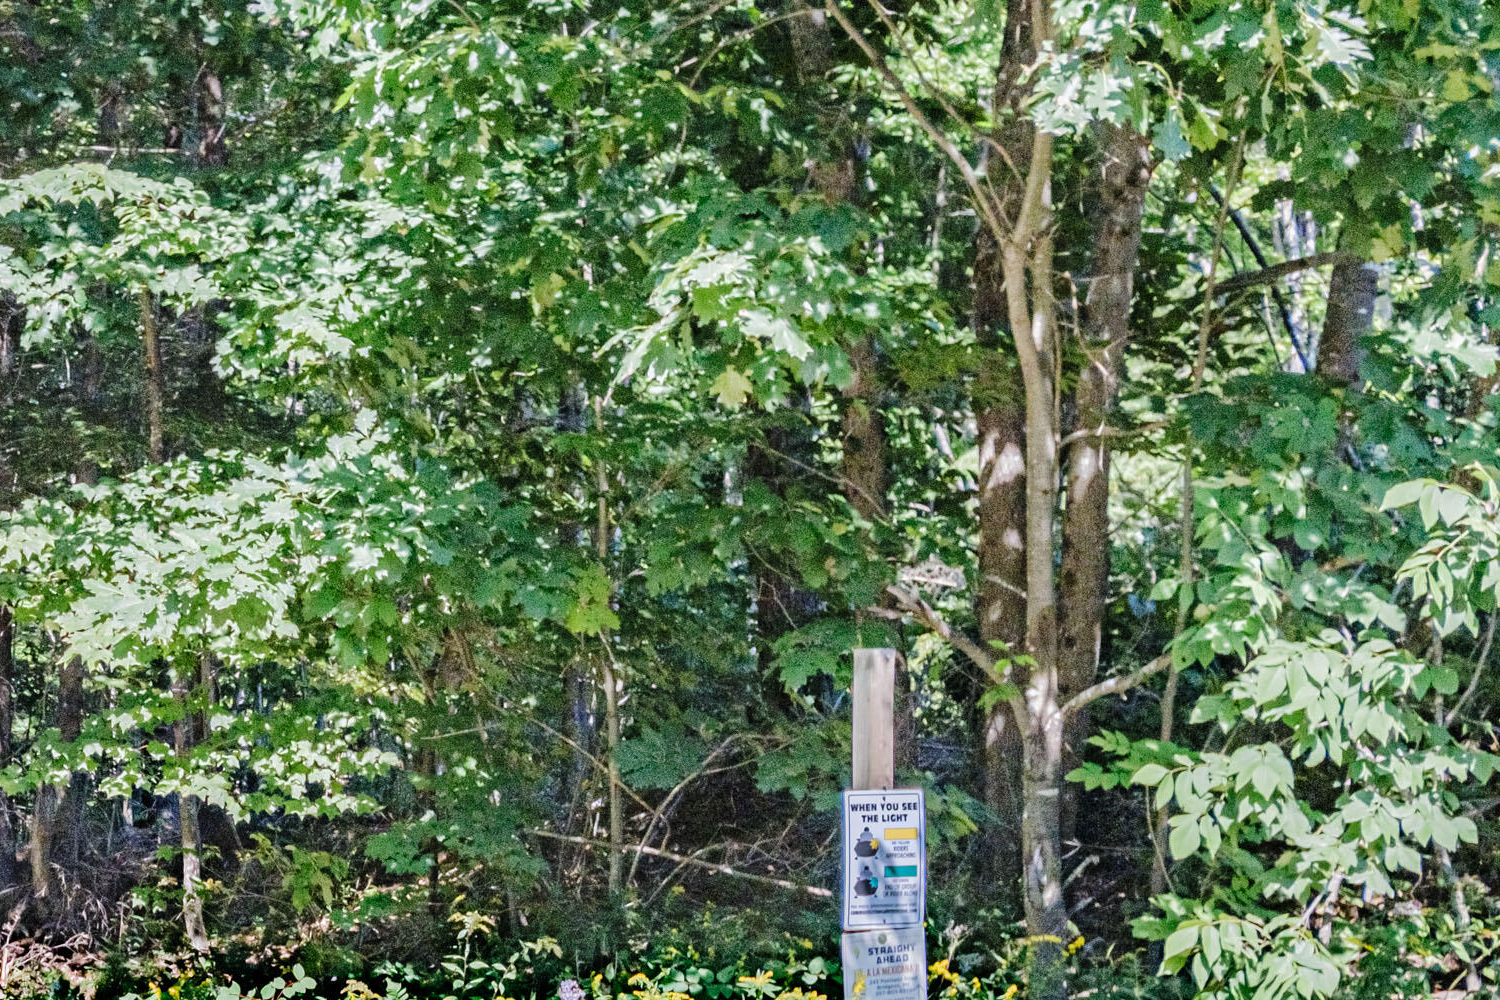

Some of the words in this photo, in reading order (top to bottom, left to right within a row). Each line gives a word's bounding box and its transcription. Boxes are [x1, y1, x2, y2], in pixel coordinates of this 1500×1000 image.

[850, 803, 877, 812] WHEN
[880, 803, 899, 811] YOU
[902, 802, 918, 811] SEE
[861, 815, 879, 823] THE
[881, 814, 908, 823] LIGHT
[868, 943, 916, 956] STRAIGHT
[876, 954, 909, 965] AHEAD
[866, 968, 871, 977] A
[872, 967, 880, 976] LA
